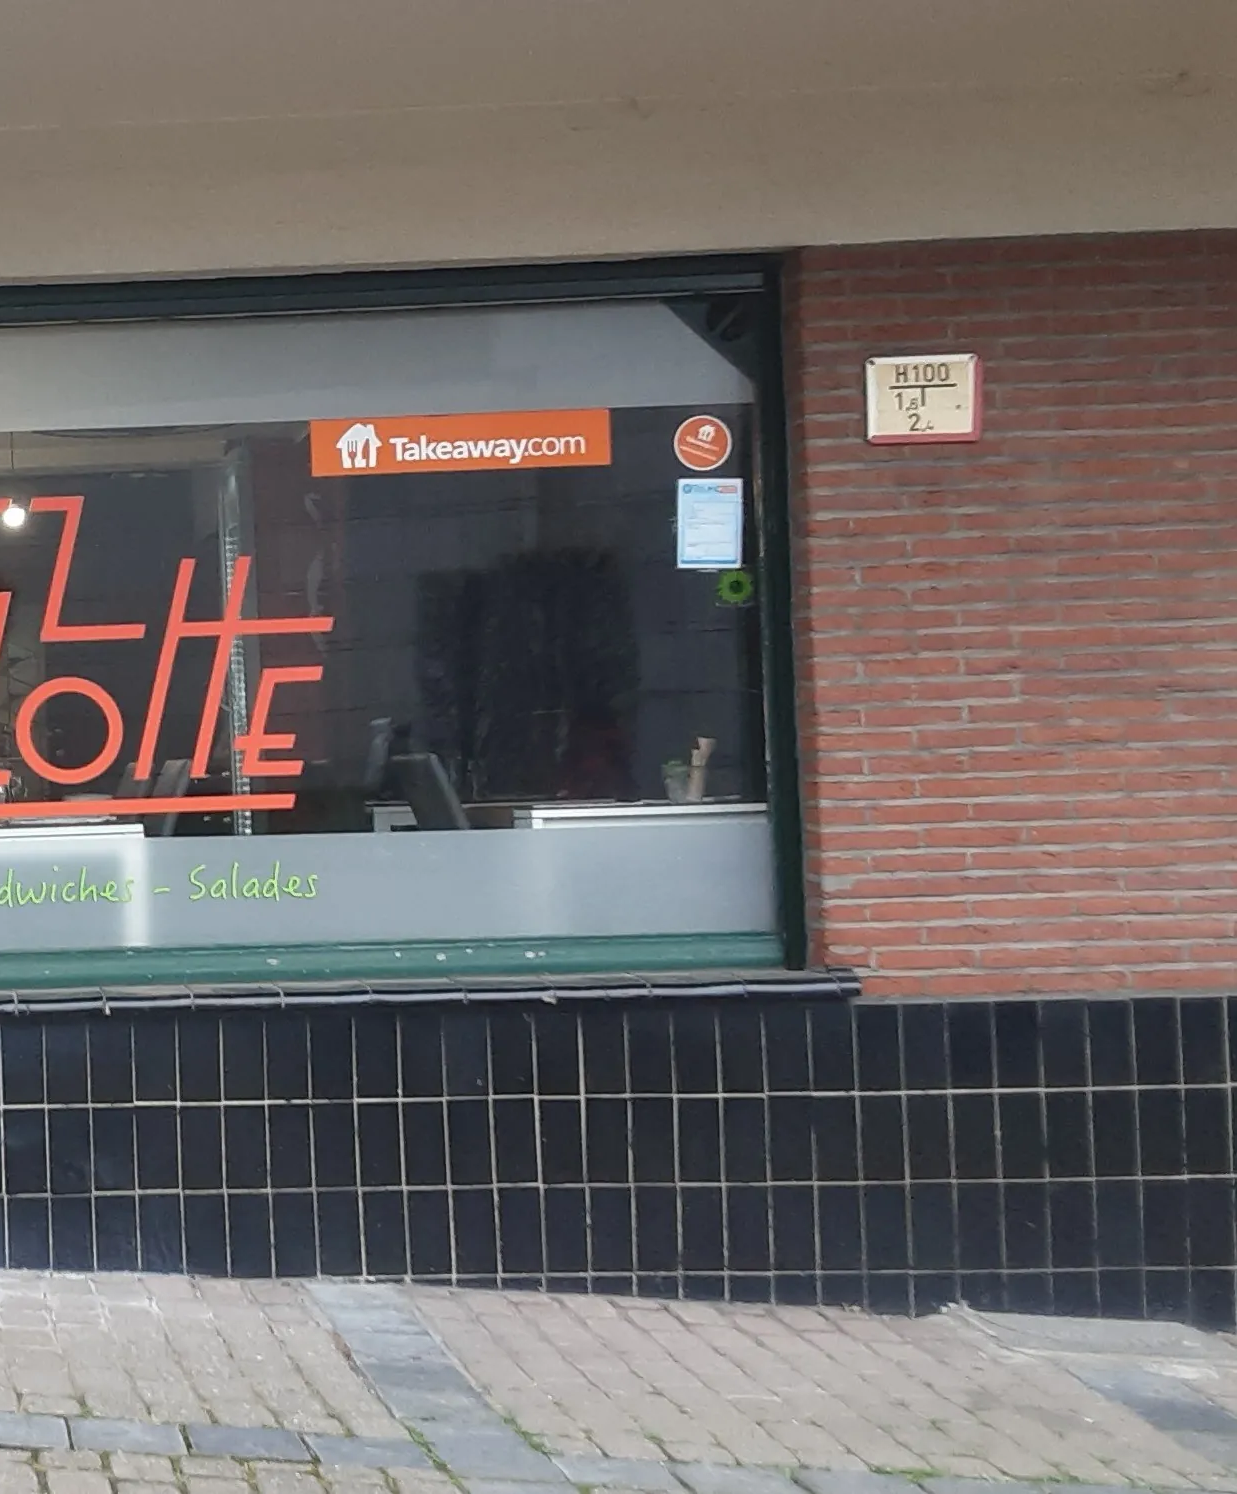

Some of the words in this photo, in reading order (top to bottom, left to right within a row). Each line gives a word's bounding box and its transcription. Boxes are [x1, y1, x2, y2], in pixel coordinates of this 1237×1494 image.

[894, 363, 950, 383] H100
[389, 434, 586, 464] Takeaway.com
[188, 861, 319, 902] Salades
